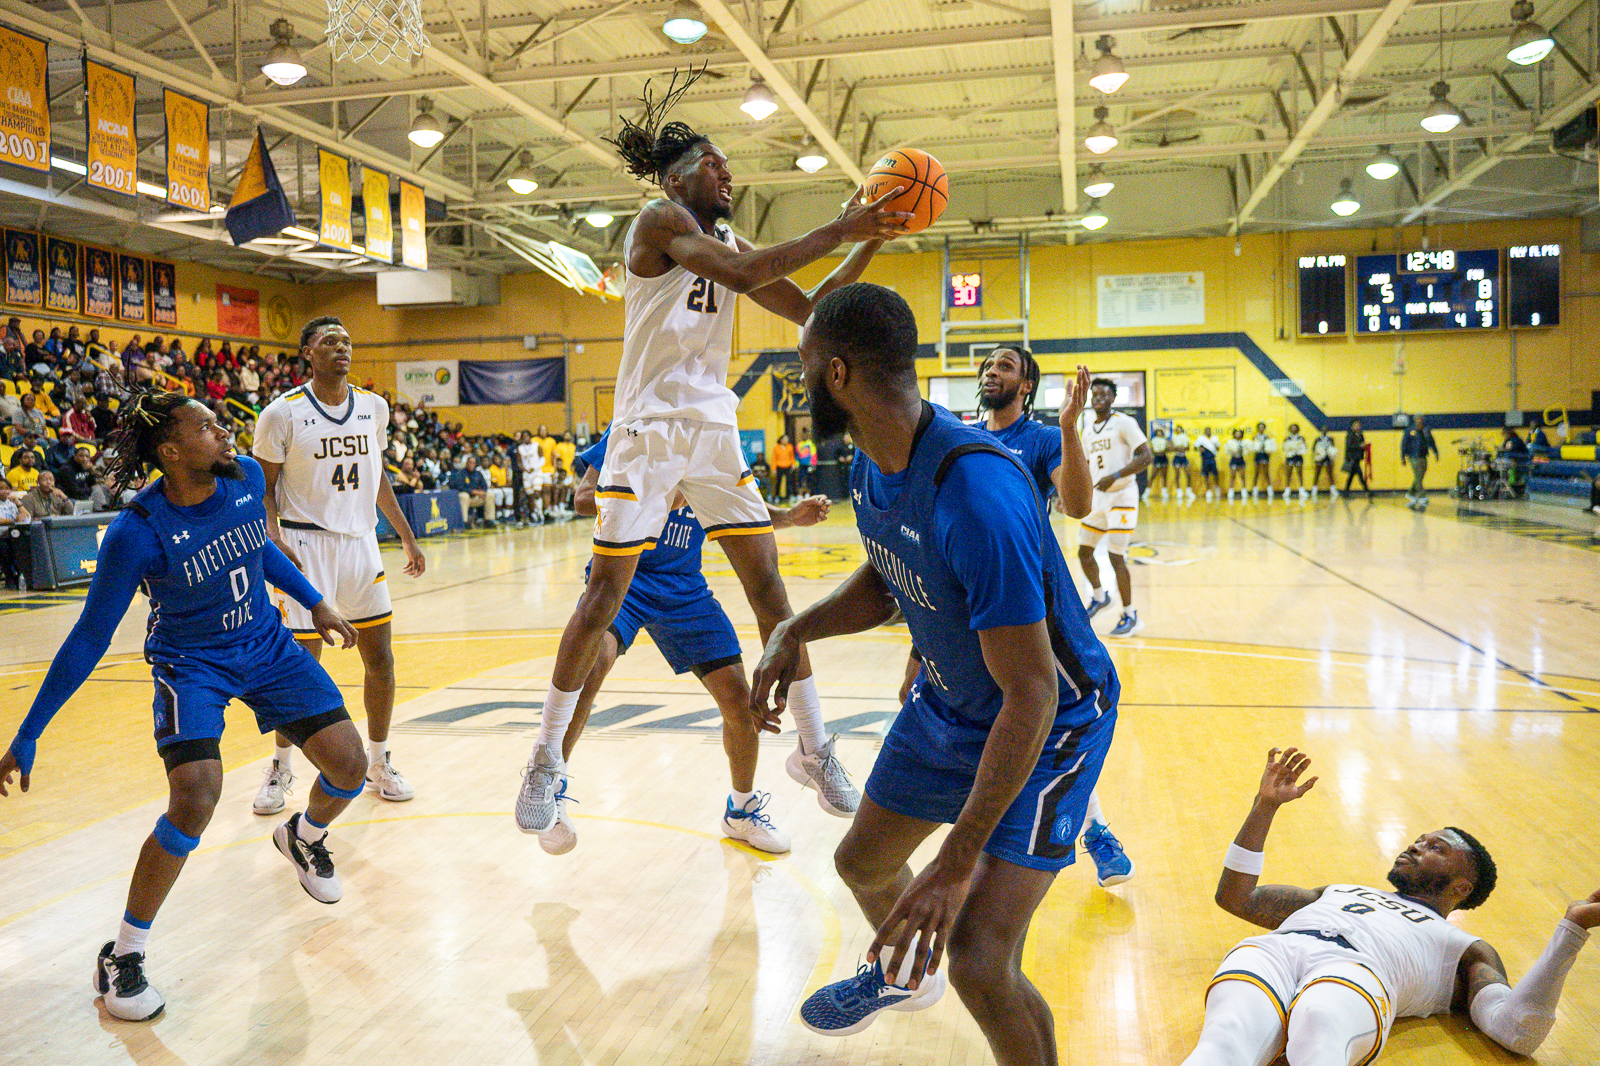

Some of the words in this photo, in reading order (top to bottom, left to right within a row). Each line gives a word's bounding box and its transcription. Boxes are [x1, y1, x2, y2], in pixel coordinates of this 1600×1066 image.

[98, 119, 128, 138] NCAA
[0, 131, 47, 164] 2001
[176, 143, 199, 161] NCAA
[91, 161, 133, 191] 2001
[171, 181, 206, 208] 2001
[1541, 244, 1560, 256] PTS
[1406, 250, 1455, 272] 12:48
[687, 276, 718, 313] 21
[953, 286, 977, 306] 30
[1380, 283, 1395, 304] 5
[1478, 279, 1492, 299] 8
[1389, 315, 1401, 330] 4
[1455, 312, 1467, 327] 4
[313, 434, 369, 460] JCSU
[1097, 455, 1104, 469] 2
[331, 462, 359, 492] 44
[235, 493, 253, 507] CIAA
[664, 522, 692, 549] STATE
[900, 525, 920, 545] CIAA
[229, 565, 249, 602] 0
[1334, 887, 1434, 923] JCSU
[1341, 902, 1376, 915] 0
